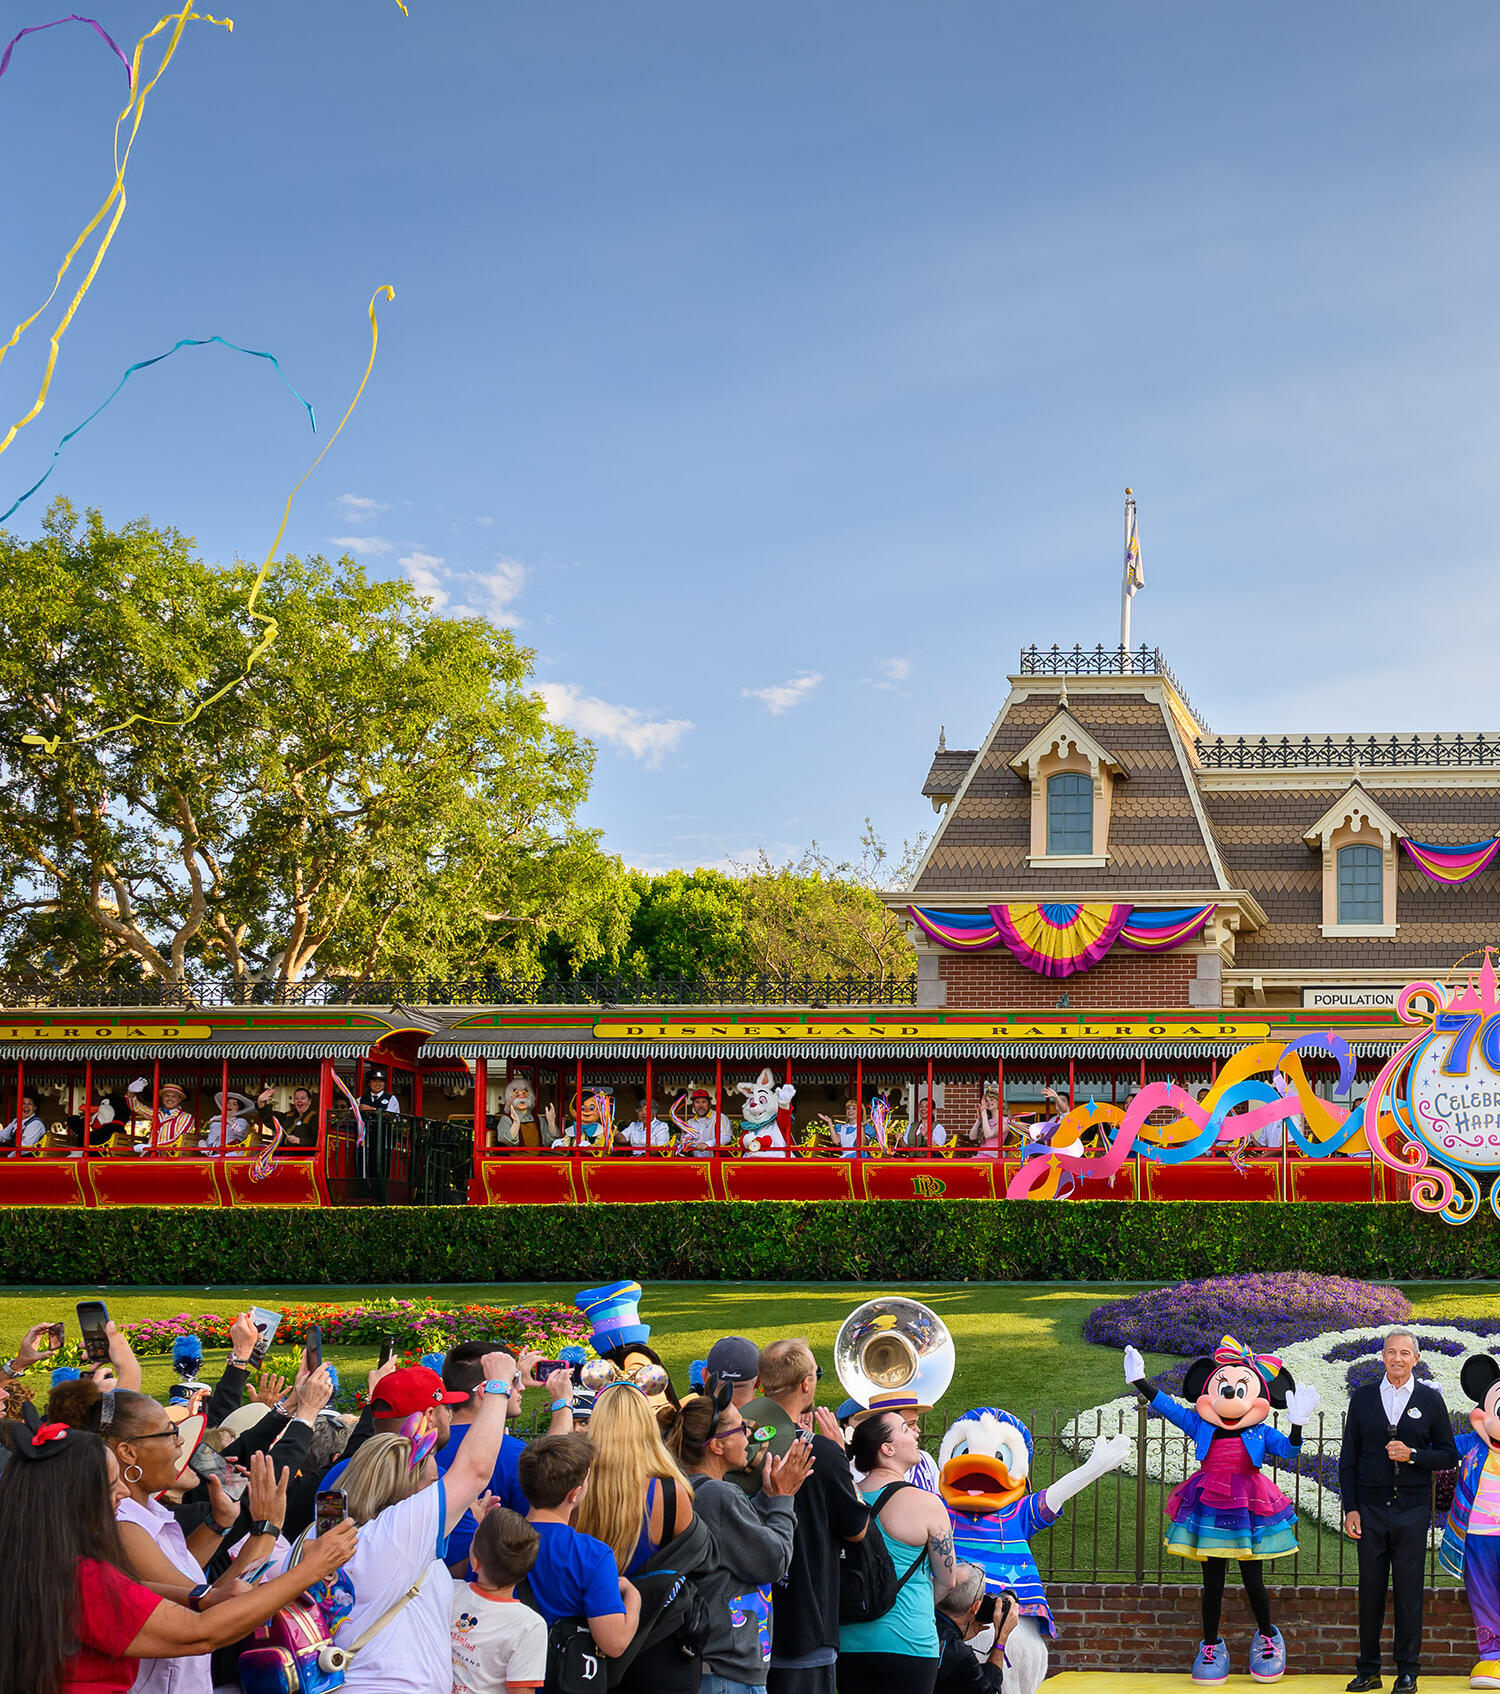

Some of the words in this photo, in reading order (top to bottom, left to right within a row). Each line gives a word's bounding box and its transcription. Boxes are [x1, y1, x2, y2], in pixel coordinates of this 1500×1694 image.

[1314, 994, 1394, 1005] POPULATION
[625, 1026, 919, 1036] DISNEYLAND
[991, 1026, 1237, 1035] RAILROAD
[581, 1652, 598, 1680] D
